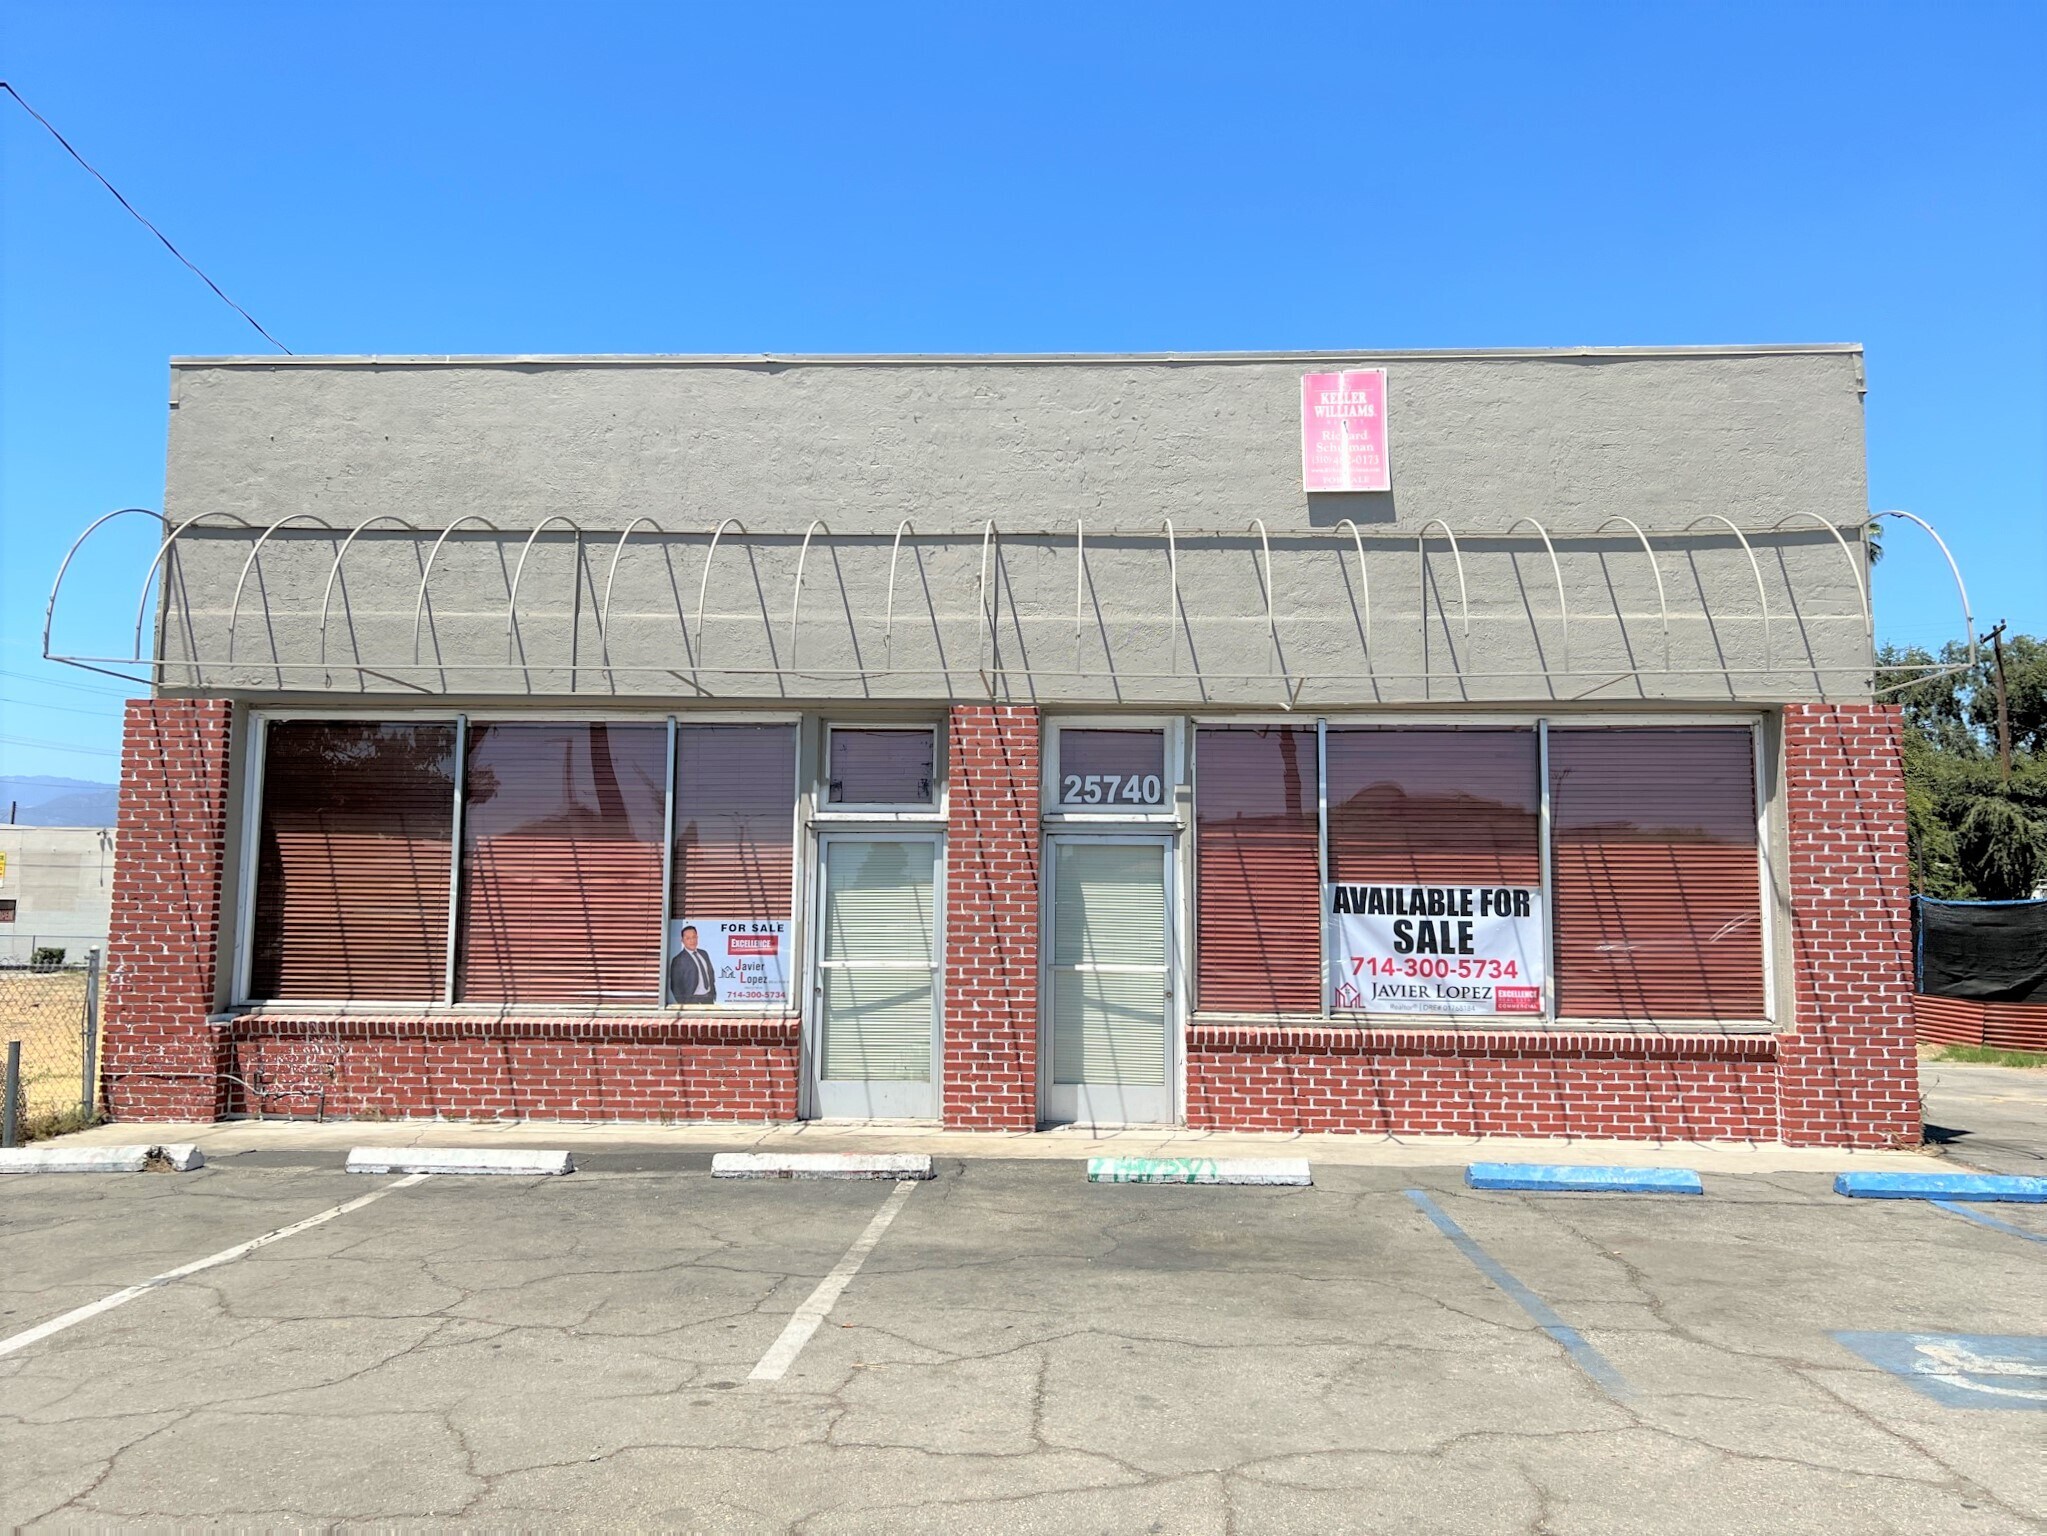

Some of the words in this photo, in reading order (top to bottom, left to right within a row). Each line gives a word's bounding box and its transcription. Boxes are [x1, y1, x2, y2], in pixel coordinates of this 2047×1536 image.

[1320, 392, 1367, 404] KELLER
[1314, 404, 1375, 418] WILLIAMS
[1321, 430, 1368, 440] Ricard
[1063, 774, 1161, 804] 25740
[1332, 886, 1473, 916] AVAILABLE
[1480, 889, 1530, 917] FOR
[721, 924, 746, 932] FOR
[751, 924, 784, 932] SALE
[1393, 919, 1475, 955] SALE
[735, 959, 765, 971] Javier
[1350, 957, 1518, 979] 714-300-5734
[740, 972, 768, 986] Lopez
[727, 991, 786, 999] 714-300-5734
[1371, 982, 1432, 1000] JAVIER
[1436, 984, 1493, 1000] LOPEZ
